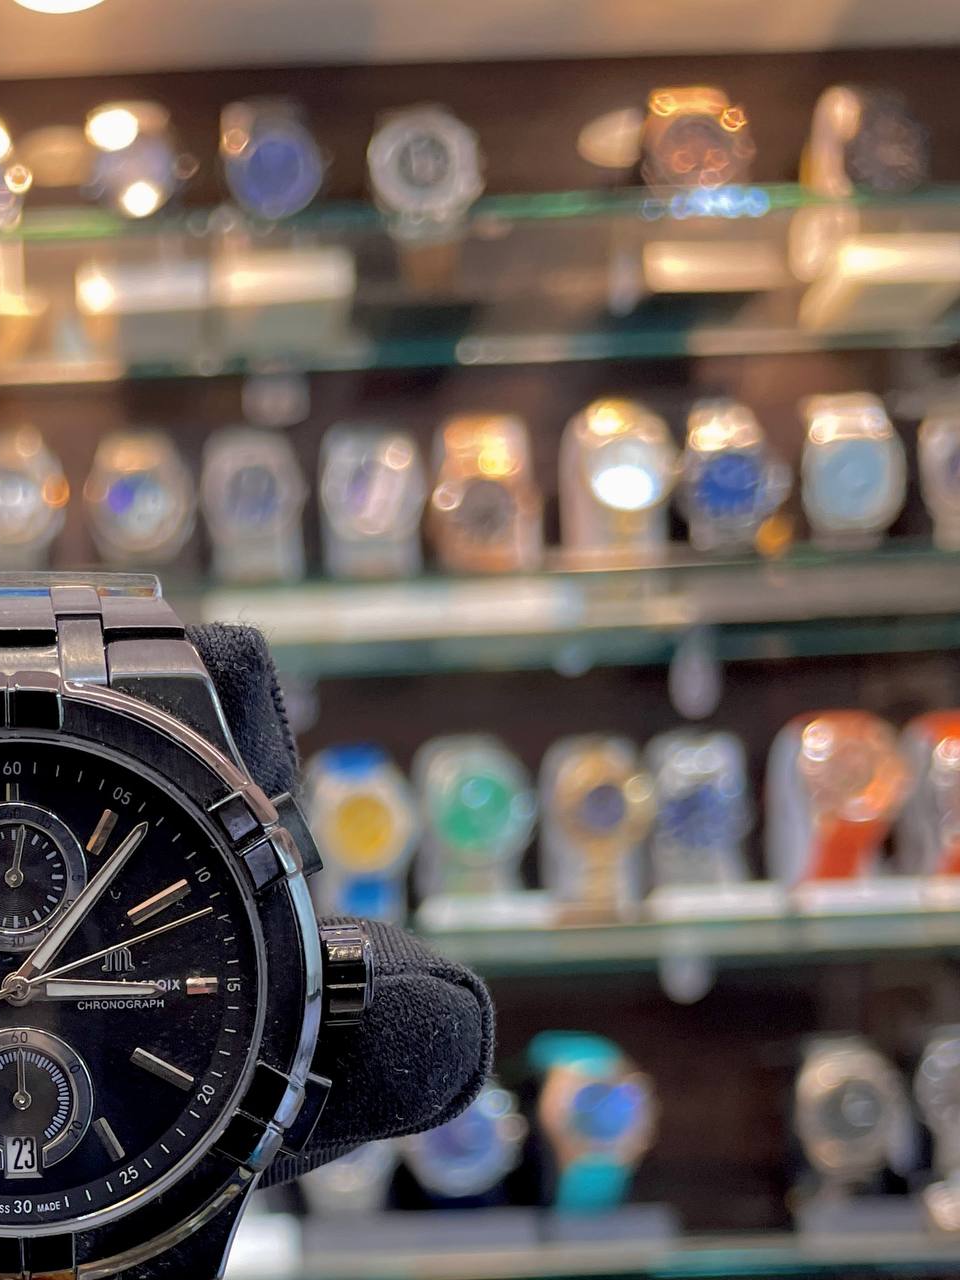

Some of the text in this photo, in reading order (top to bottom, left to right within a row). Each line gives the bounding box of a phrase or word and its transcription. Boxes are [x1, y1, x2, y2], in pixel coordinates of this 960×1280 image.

[3, 761, 22, 776] 60
[113, 786, 132, 805] 05
[194, 866, 211, 883] 10
[227, 978, 240, 992] 15
[77, 999, 165, 1010] CHRONOGRAPH
[11, 1031, 28, 1044] 60
[197, 1084, 215, 1105] 20
[12, 1137, 35, 1170] 23
[118, 1165, 139, 1185] 25
[13, 1199, 32, 1214] 30
[36, 1200, 61, 1213] MADE
